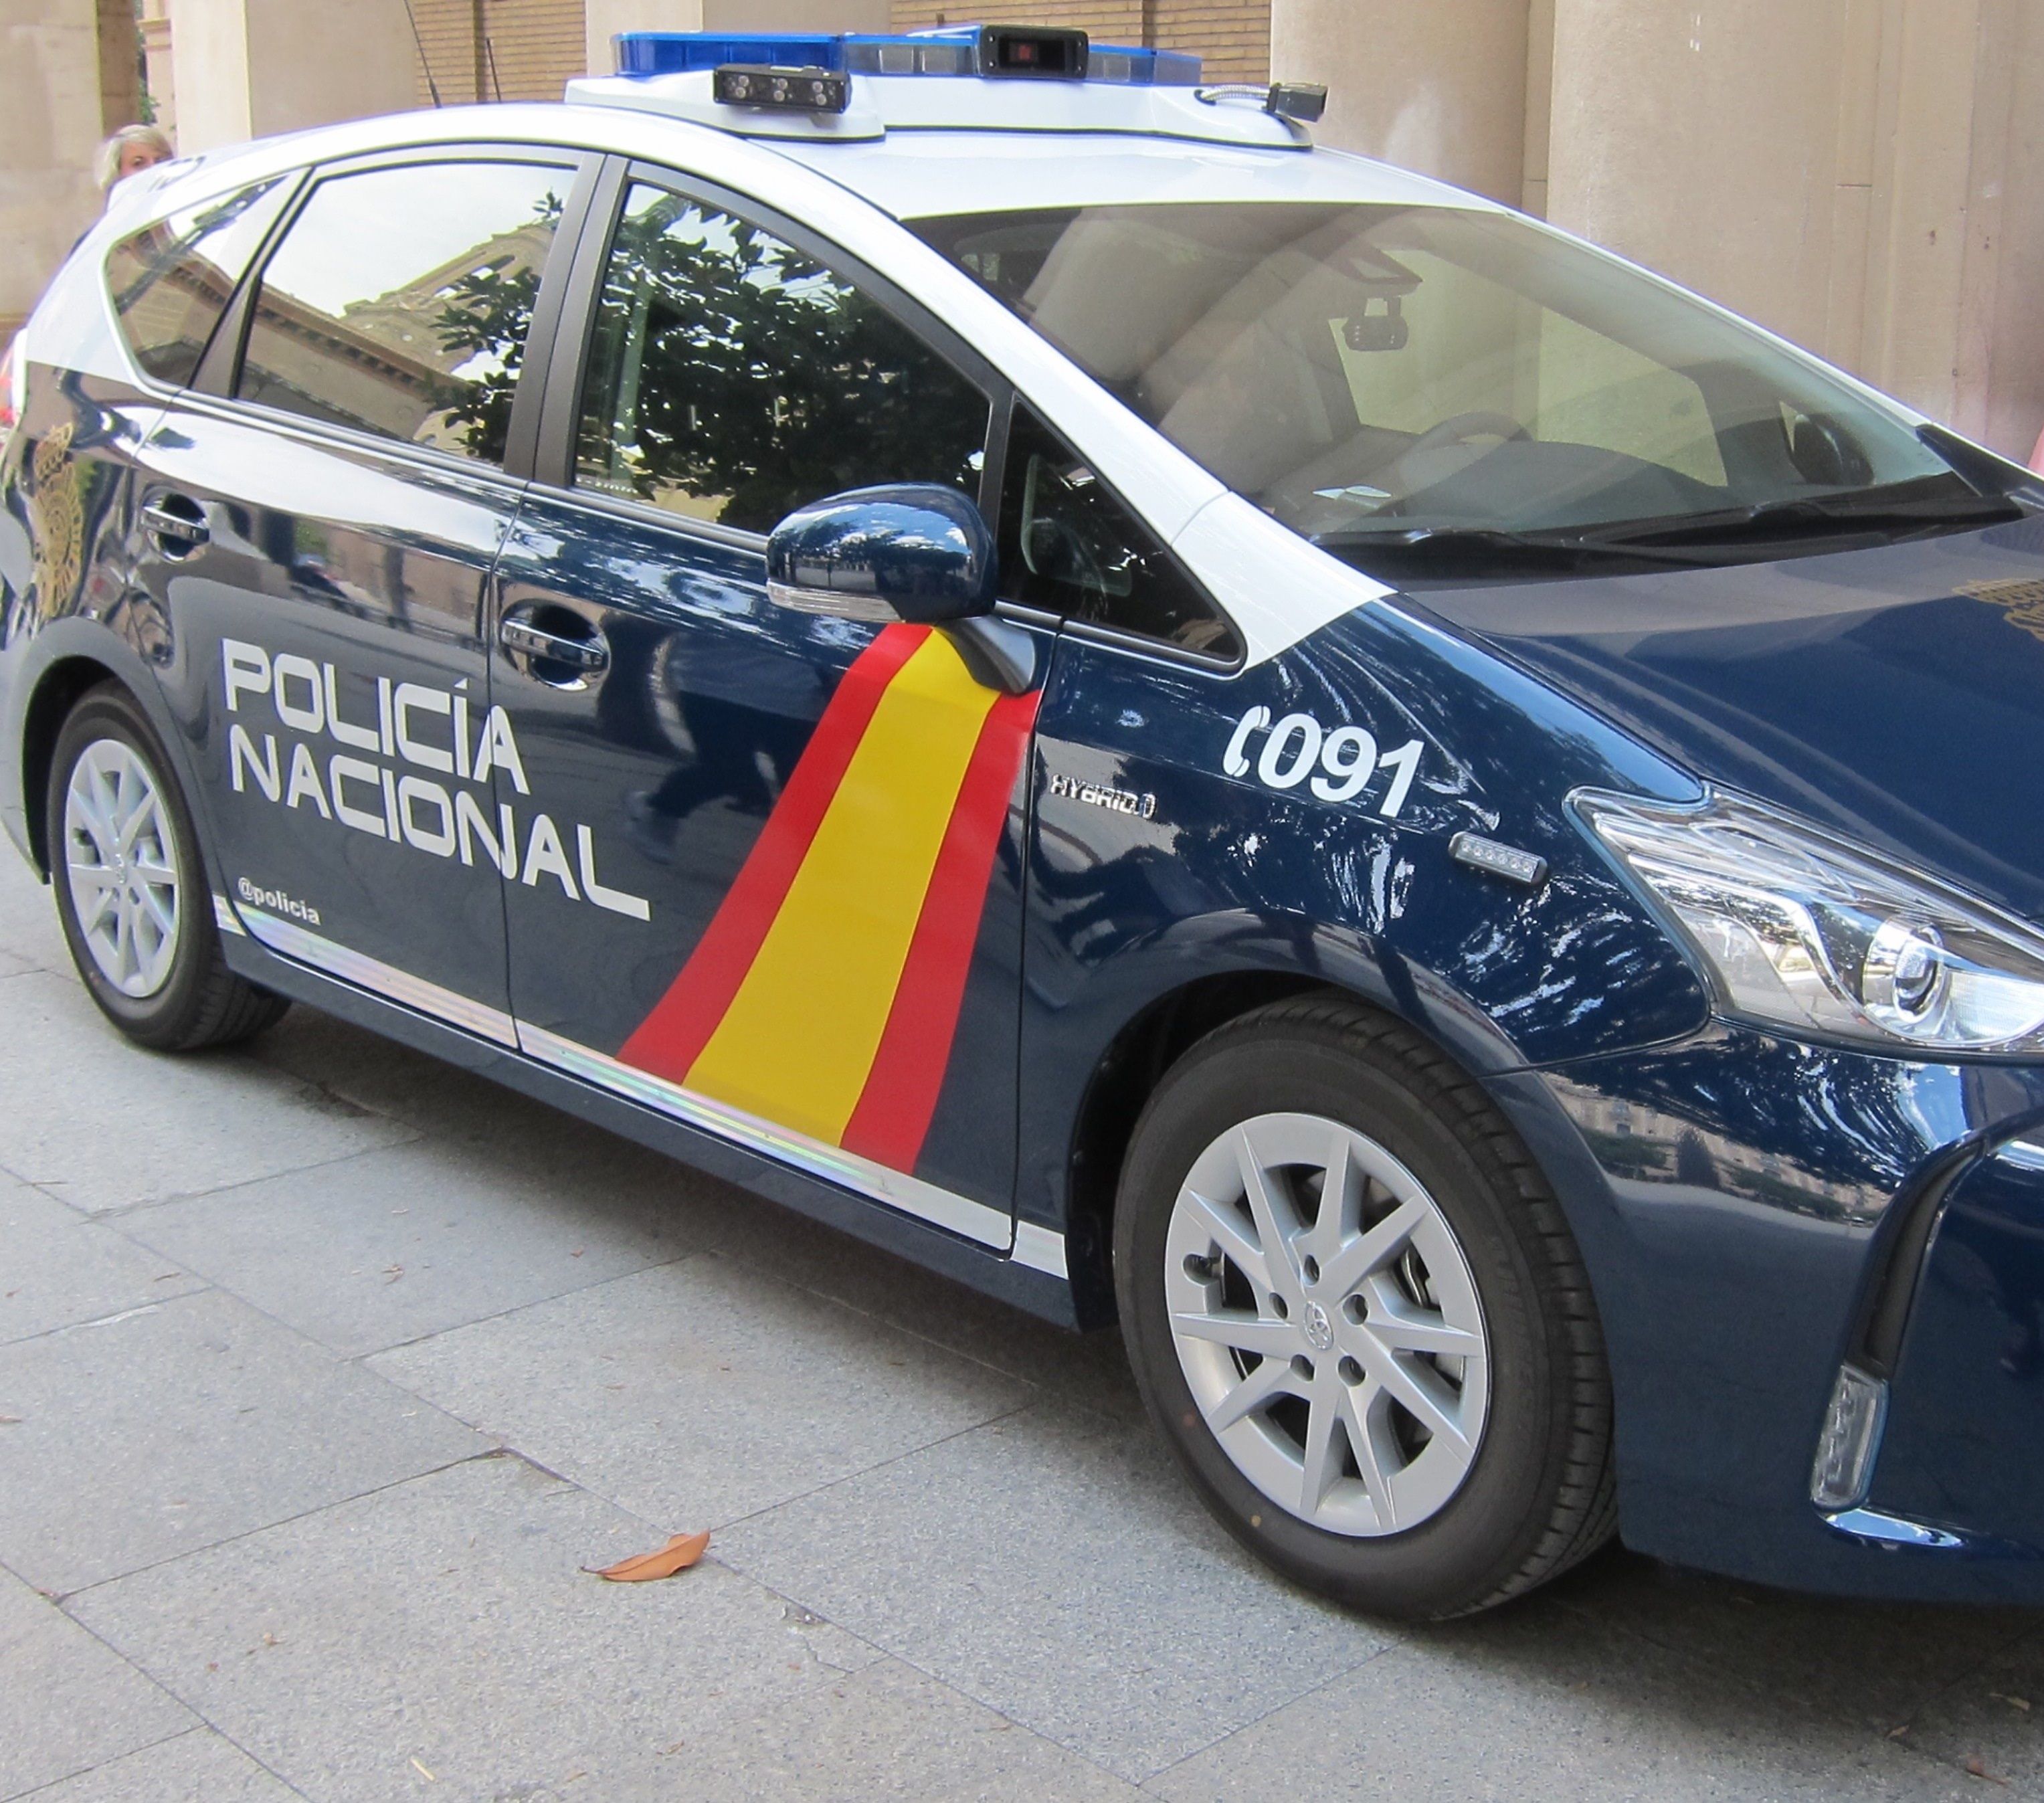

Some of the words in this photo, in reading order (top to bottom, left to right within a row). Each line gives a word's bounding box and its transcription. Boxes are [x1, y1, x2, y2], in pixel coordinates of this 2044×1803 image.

[221, 638, 530, 795] POLICÍA
[1257, 713, 1424, 818] 091
[229, 724, 650, 921] NACIONAL
[238, 876, 321, 927] @policia
